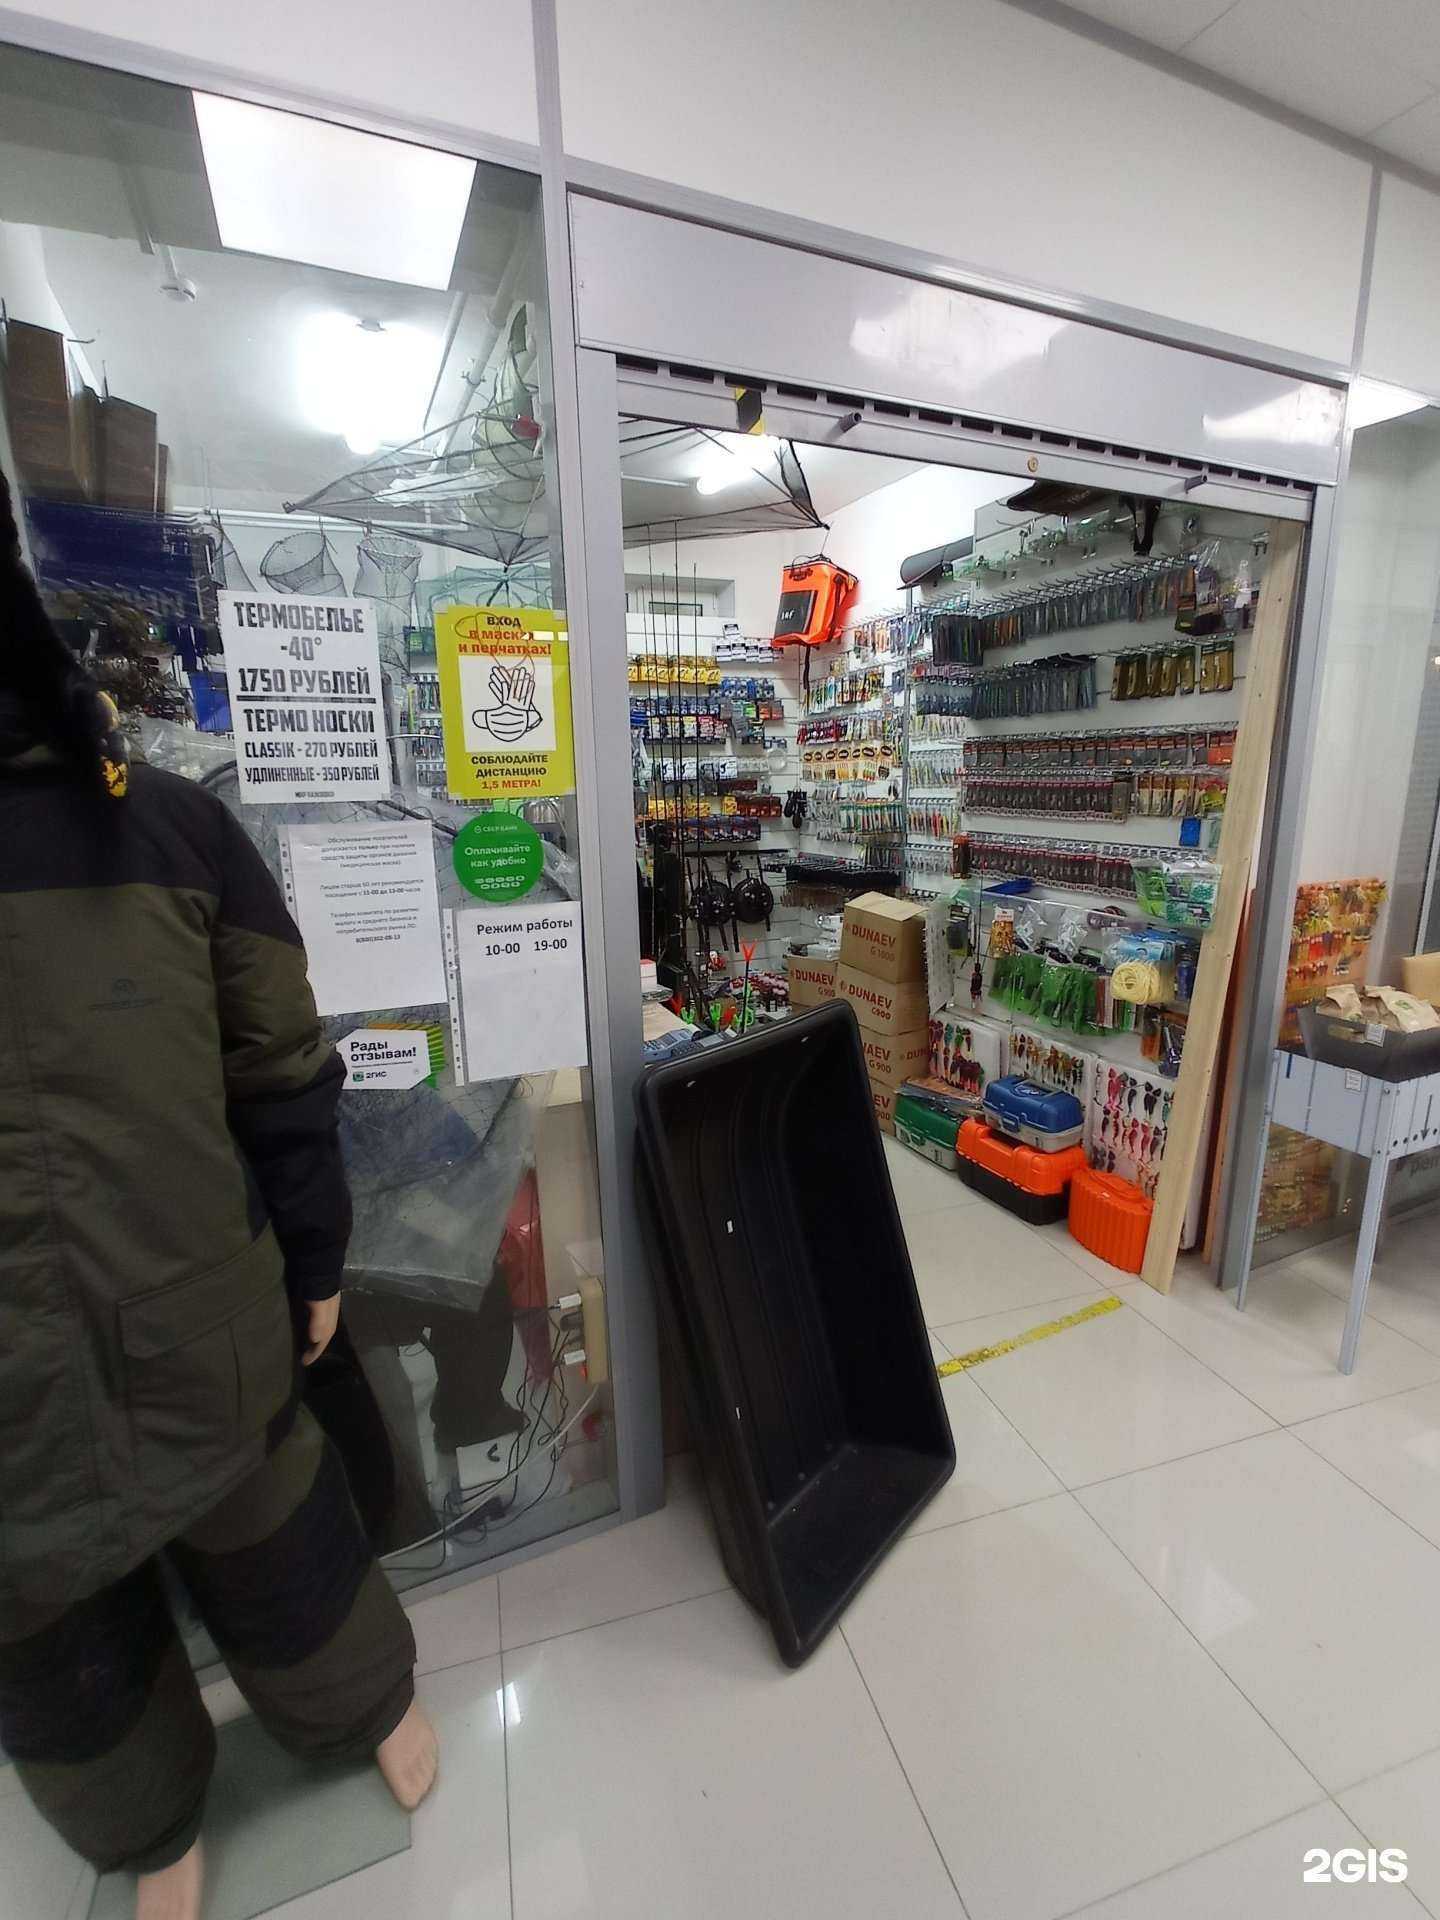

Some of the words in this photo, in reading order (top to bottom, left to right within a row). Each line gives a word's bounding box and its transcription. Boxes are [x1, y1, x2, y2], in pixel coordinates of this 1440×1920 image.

[233, 602, 364, 633] ТЕРМОБЕЛЬЕ
[486, 616, 522, 627] ВХОД
[459, 643, 468, 653] и
[471, 643, 552, 655] перчатках!
[238, 668, 286, 692] 1750
[289, 666, 371, 694] РУБЛЕЙ
[243, 709, 308, 732] ТЕРМО
[311, 709, 375, 733] НОСКИ
[244, 742, 295, 758] CLASSIK
[304, 742, 328, 758] 270
[330, 739, 378, 758] РУБЛЕЙ
[471, 753, 549, 765] СОБЛЮДАЙТЕ
[245, 767, 316, 784] УДЛИНЕННЫЕ
[322, 767, 340, 781] 350
[341, 764, 380, 781] РУБЛЕЙ
[476, 767, 547, 779] ДИСТАНЦИЮ
[502, 779, 541, 789] МЕТРА!
[464, 843, 531, 856] Оплачивайте
[470, 859, 489, 868] как
[491, 856, 526, 868] удобно
[476, 923, 523, 935] Режим
[526, 918, 573, 934] работы
[852, 924, 896, 948] DUNAEV
[485, 942, 520, 956] 10-00
[534, 938, 568, 951] 19-00
[795, 969, 834, 986] DUNAEV
[848, 984, 893, 1009] DUNAEV
[350, 1041, 388, 1052] Рады
[350, 1047, 417, 1062] отзывам!
[366, 1071, 388, 1079] 2ГИС
